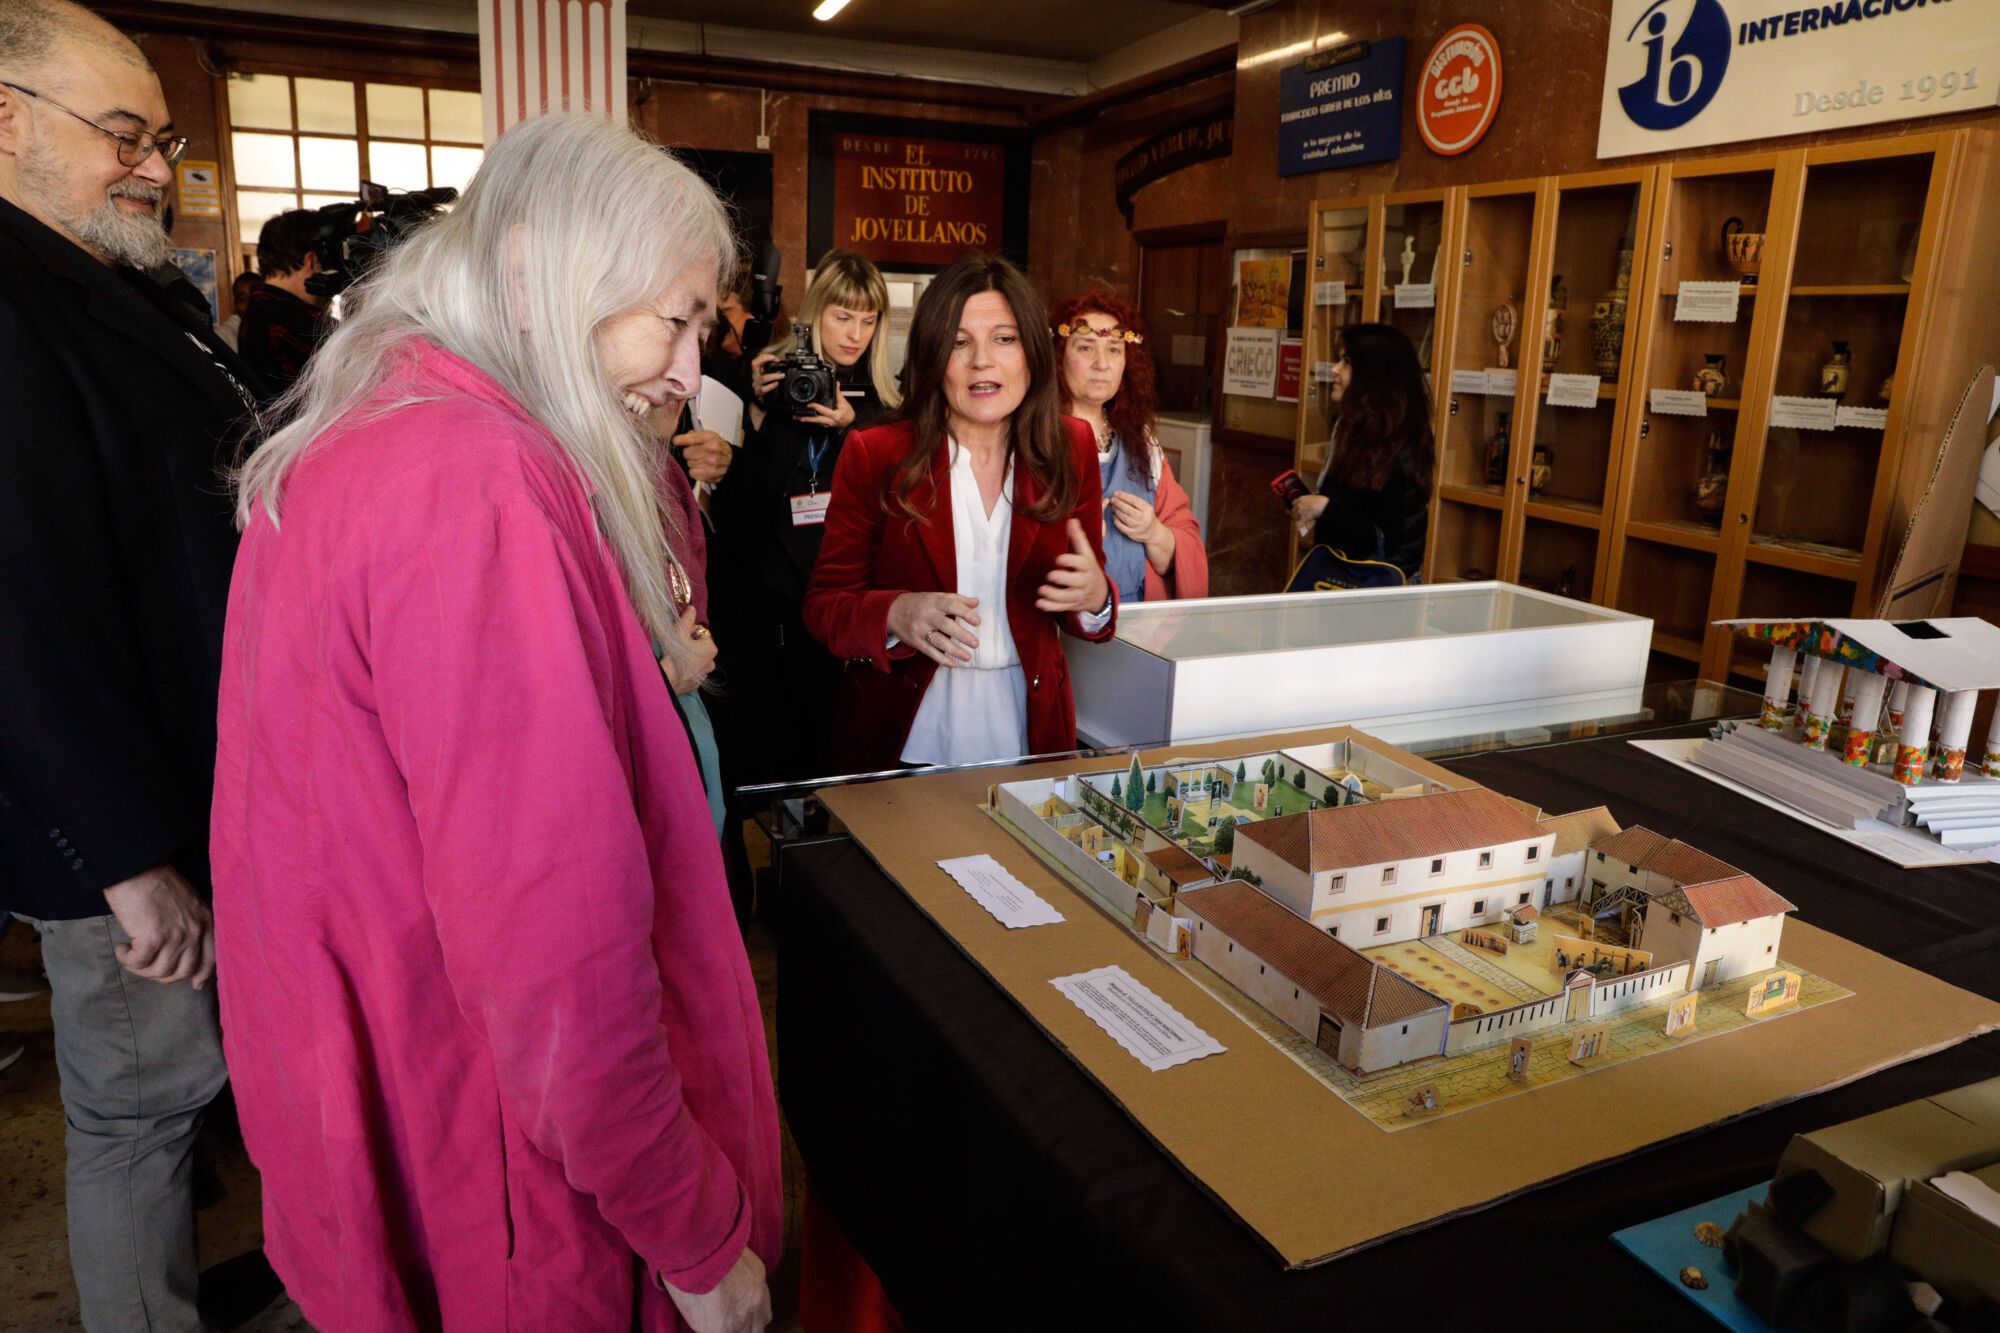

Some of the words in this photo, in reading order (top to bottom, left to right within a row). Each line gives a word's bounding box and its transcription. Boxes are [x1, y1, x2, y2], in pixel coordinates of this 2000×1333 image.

[1310, 72, 1361, 99] PREMIO
[1434, 66, 1480, 100] ccb
[1793, 79, 1885, 117] Desde
[1899, 66, 1978, 102] 1991
[905, 144, 931, 166] EL
[861, 165, 974, 193] INSTITUTO
[905, 194, 931, 216] DE
[851, 217, 987, 245] JOVELLANOS
